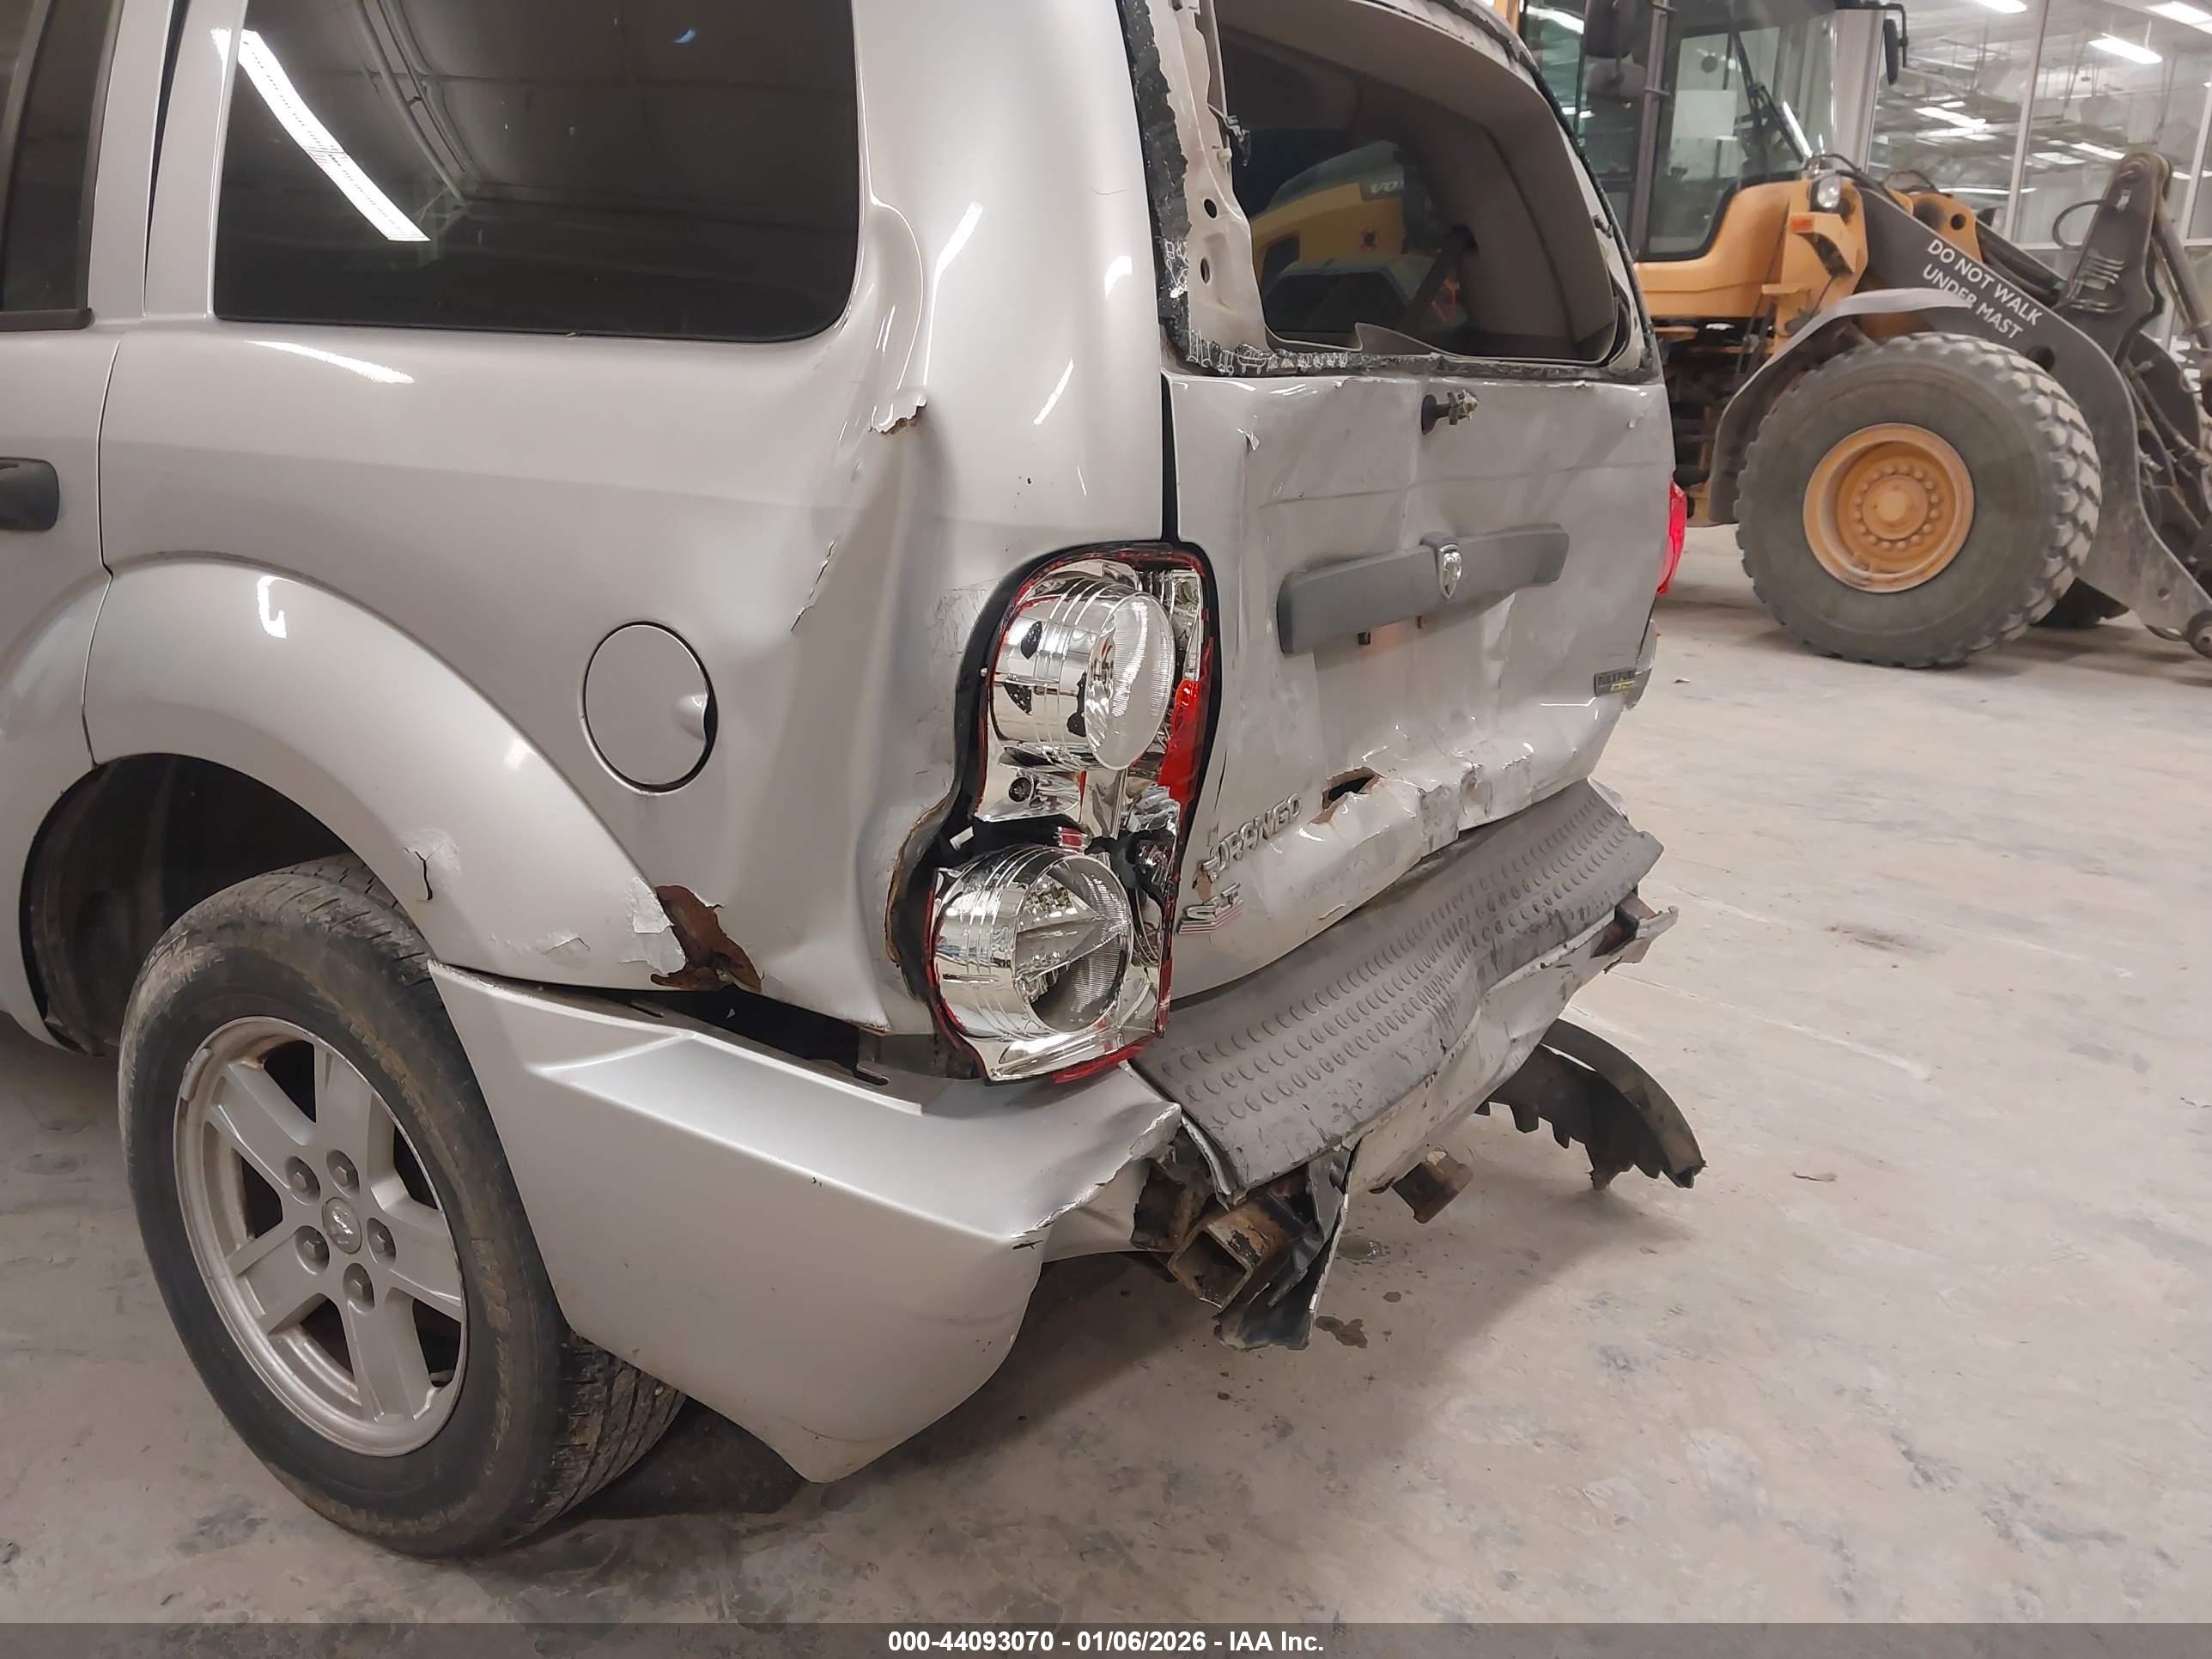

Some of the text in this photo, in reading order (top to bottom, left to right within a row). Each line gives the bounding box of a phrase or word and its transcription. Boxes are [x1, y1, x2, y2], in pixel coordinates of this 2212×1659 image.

[1923, 264, 2024, 339] UNDER MAST
[1928, 239, 2043, 326] DO NOT WALK
